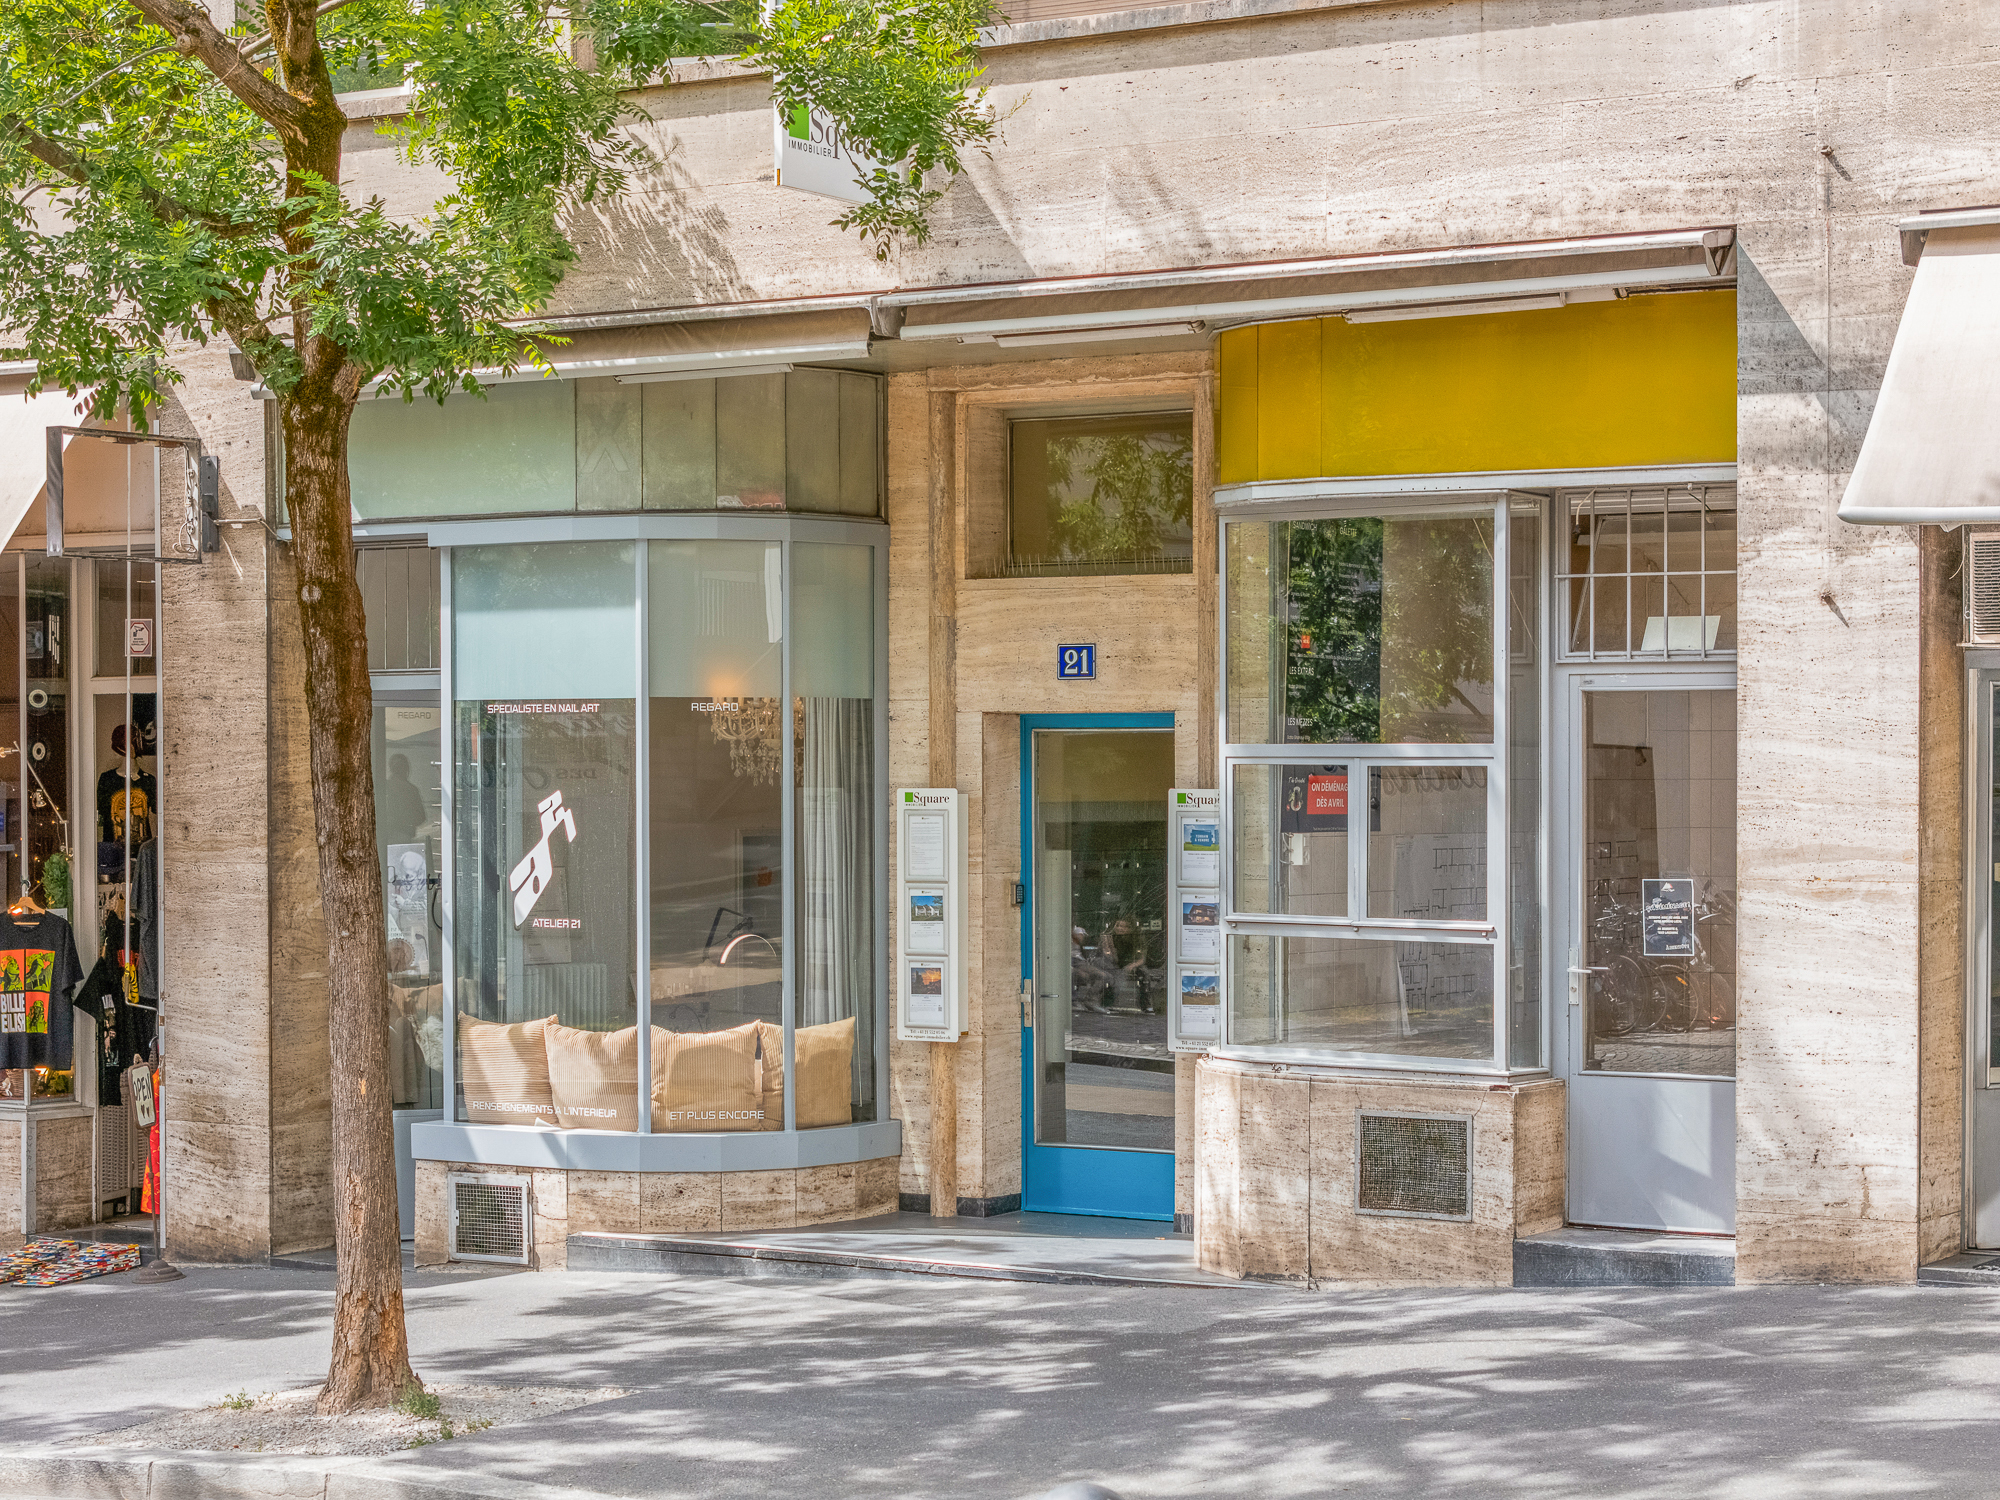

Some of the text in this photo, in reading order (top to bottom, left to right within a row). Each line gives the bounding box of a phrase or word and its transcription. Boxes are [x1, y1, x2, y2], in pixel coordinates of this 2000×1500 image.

[788, 139, 832, 158] IMMOBILIER
[1064, 649, 1089, 674] 21
[487, 703, 600, 714] SPECIALISTE EN NAIL ART
[691, 702, 739, 711] REGARD
[397, 711, 432, 720] REGARD
[1287, 718, 1296, 726] LES
[1311, 780, 1348, 792] ON DÉMÉNAG
[913, 791, 950, 806] Square
[1316, 796, 1345, 808] DÈS AVRIL
[532, 918, 581, 929] ATELIER 21
[0, 993, 25, 1013] BILLIE
[1, 1013, 26, 1033] EILISH
[133, 1072, 152, 1101] OPEN
[472, 1101, 617, 1119] RENSEIGNEMENTS A L'INTERIEUR
[670, 1110, 765, 1120] ET PLUS ENCORE
